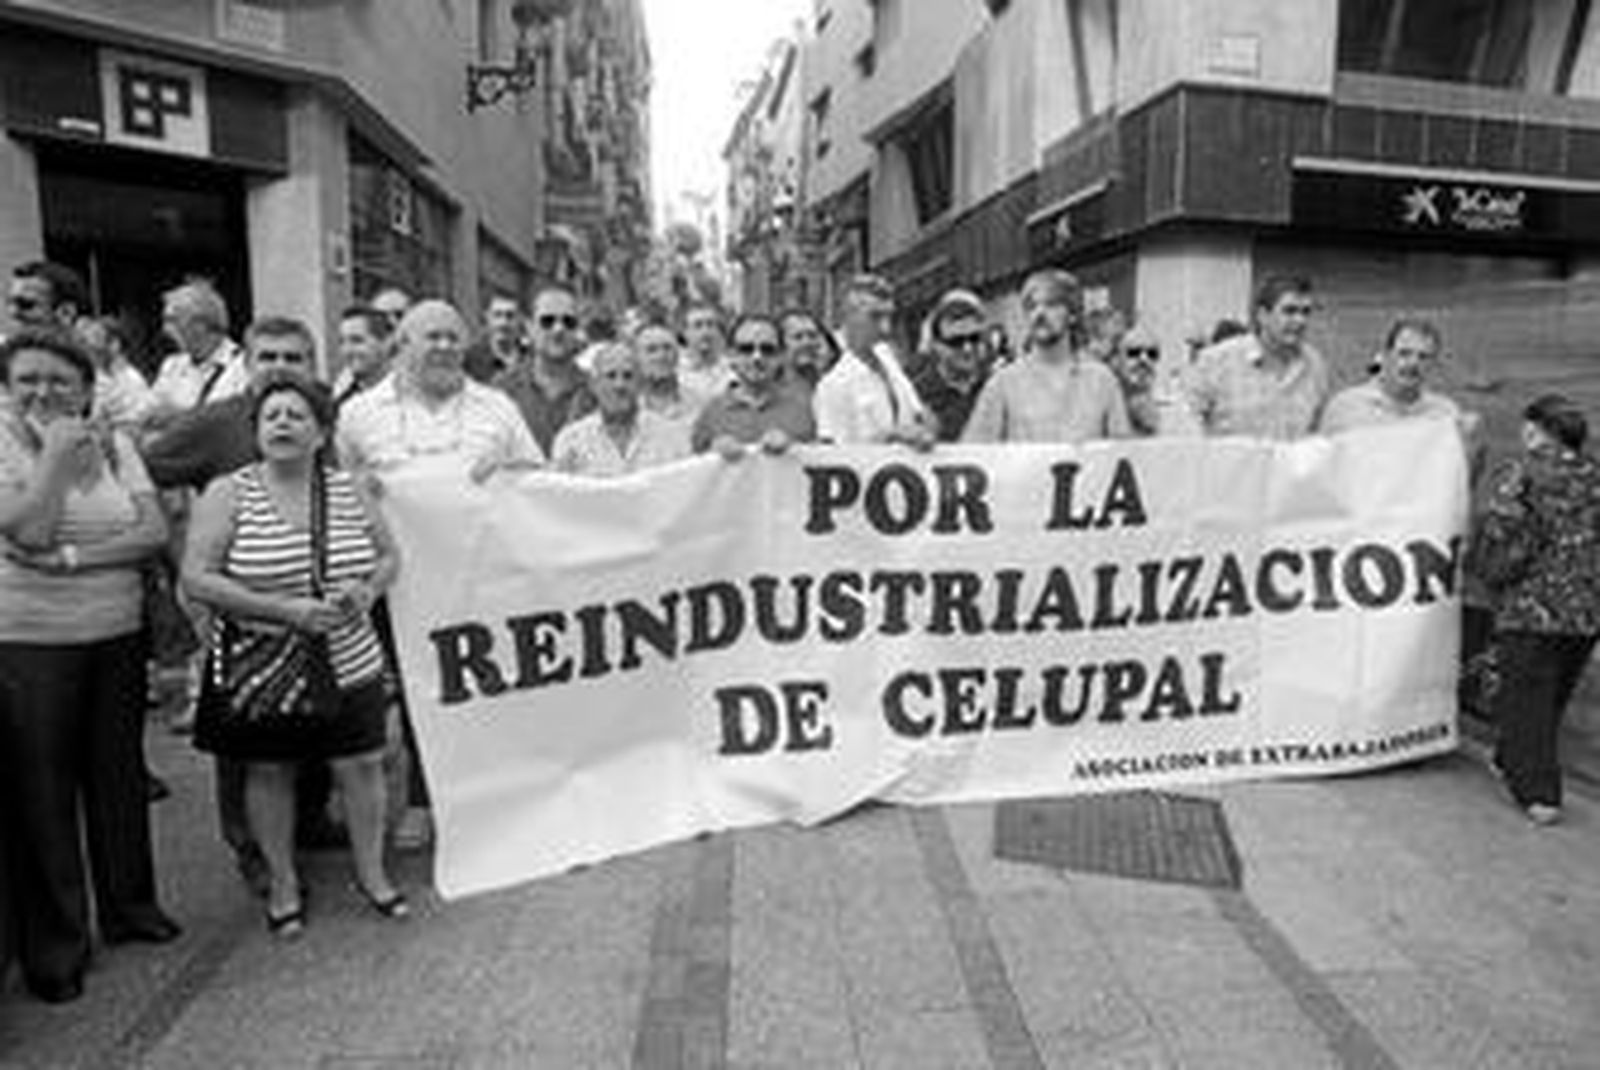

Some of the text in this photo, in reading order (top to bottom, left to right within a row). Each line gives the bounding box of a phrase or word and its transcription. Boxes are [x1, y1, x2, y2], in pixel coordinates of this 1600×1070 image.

[803, 458, 1147, 535] POR LA
[428, 535, 1462, 706] REINDUSTRIALIZACION
[714, 653, 1241, 755] DE CELUPAL
[1071, 754, 1207, 779] ASOCIACION
[1215, 749, 1242, 766] DE
